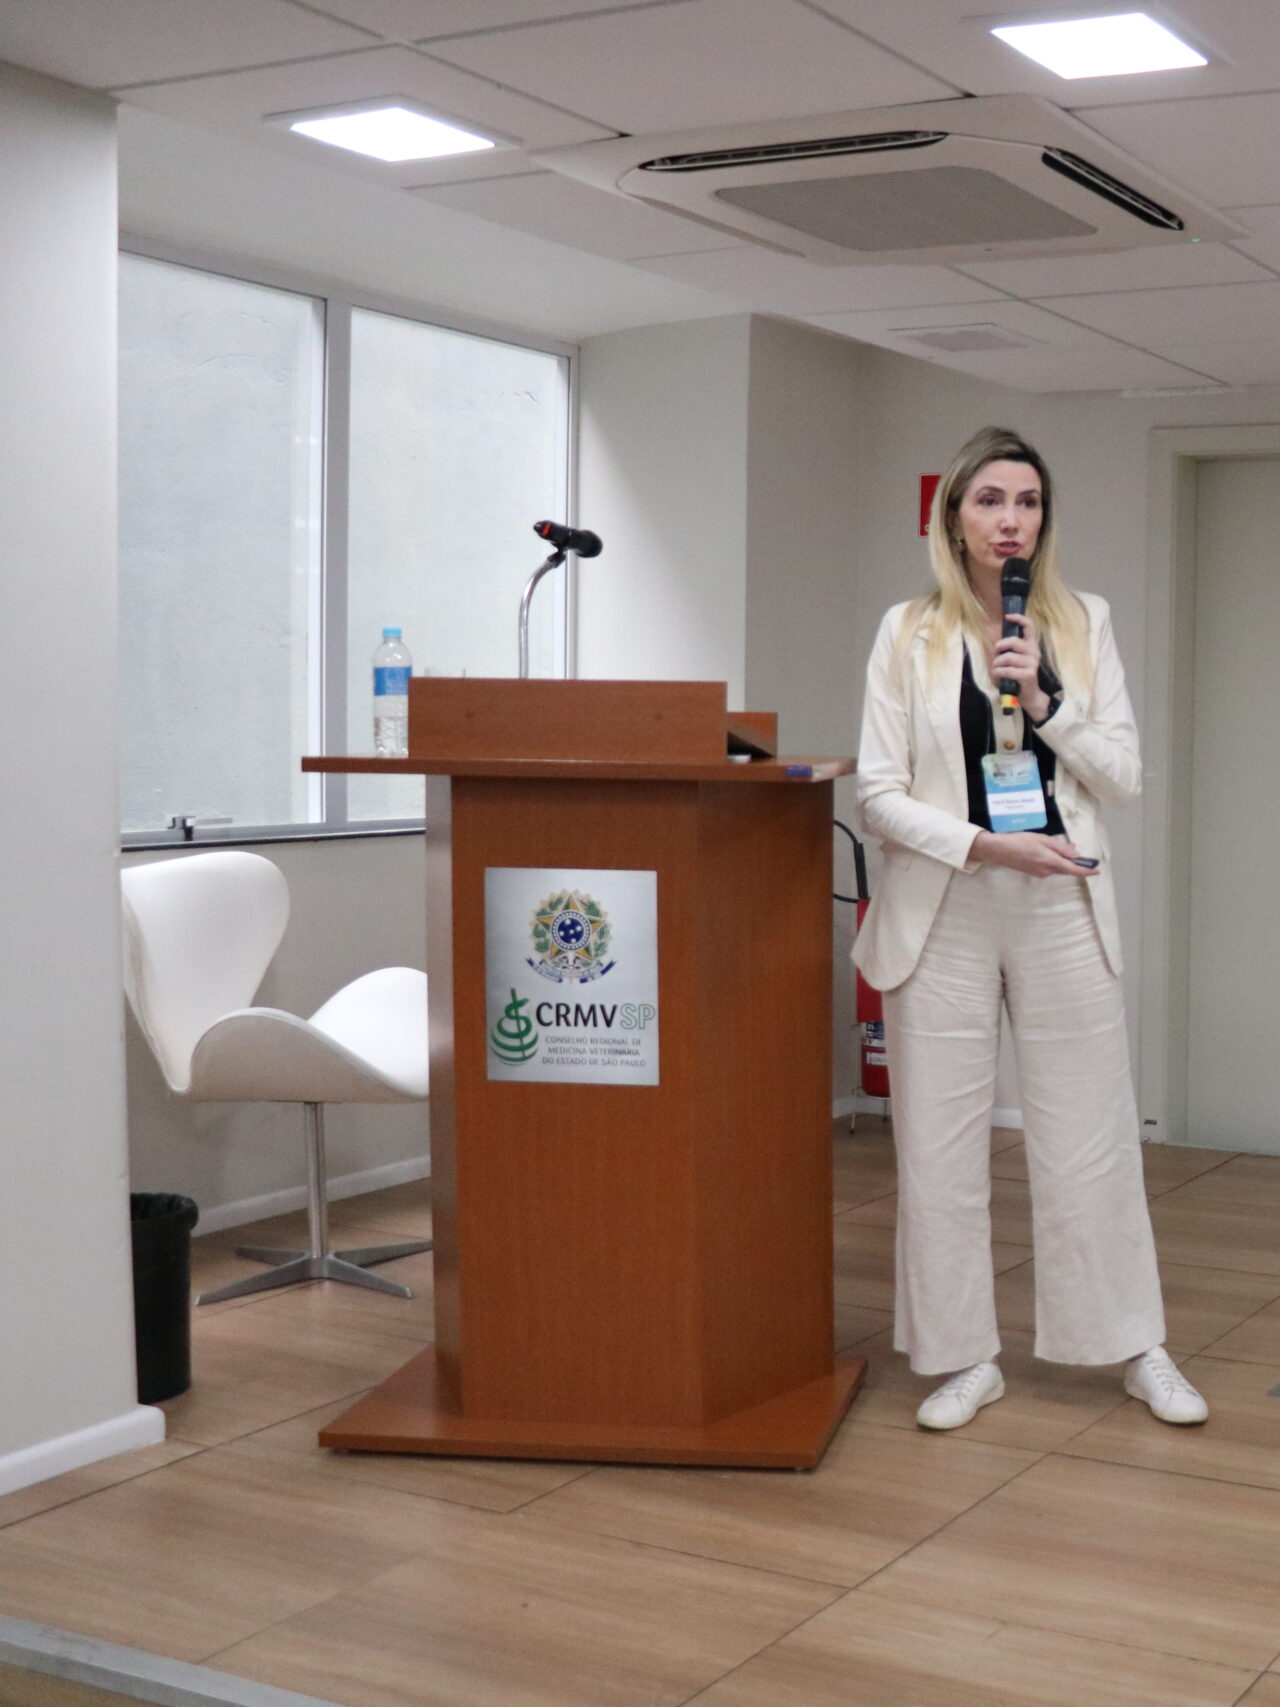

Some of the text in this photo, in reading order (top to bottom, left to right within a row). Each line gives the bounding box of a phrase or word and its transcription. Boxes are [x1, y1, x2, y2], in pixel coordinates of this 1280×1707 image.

[545, 1036, 588, 1045] CONSELHO
[590, 1037, 629, 1046] REGIONAL
[547, 1046, 587, 1055] MEDICINA
[542, 1056, 554, 1064] DO
[556, 1057, 587, 1066] ESTADO
[620, 1058, 647, 1068] PAULO
